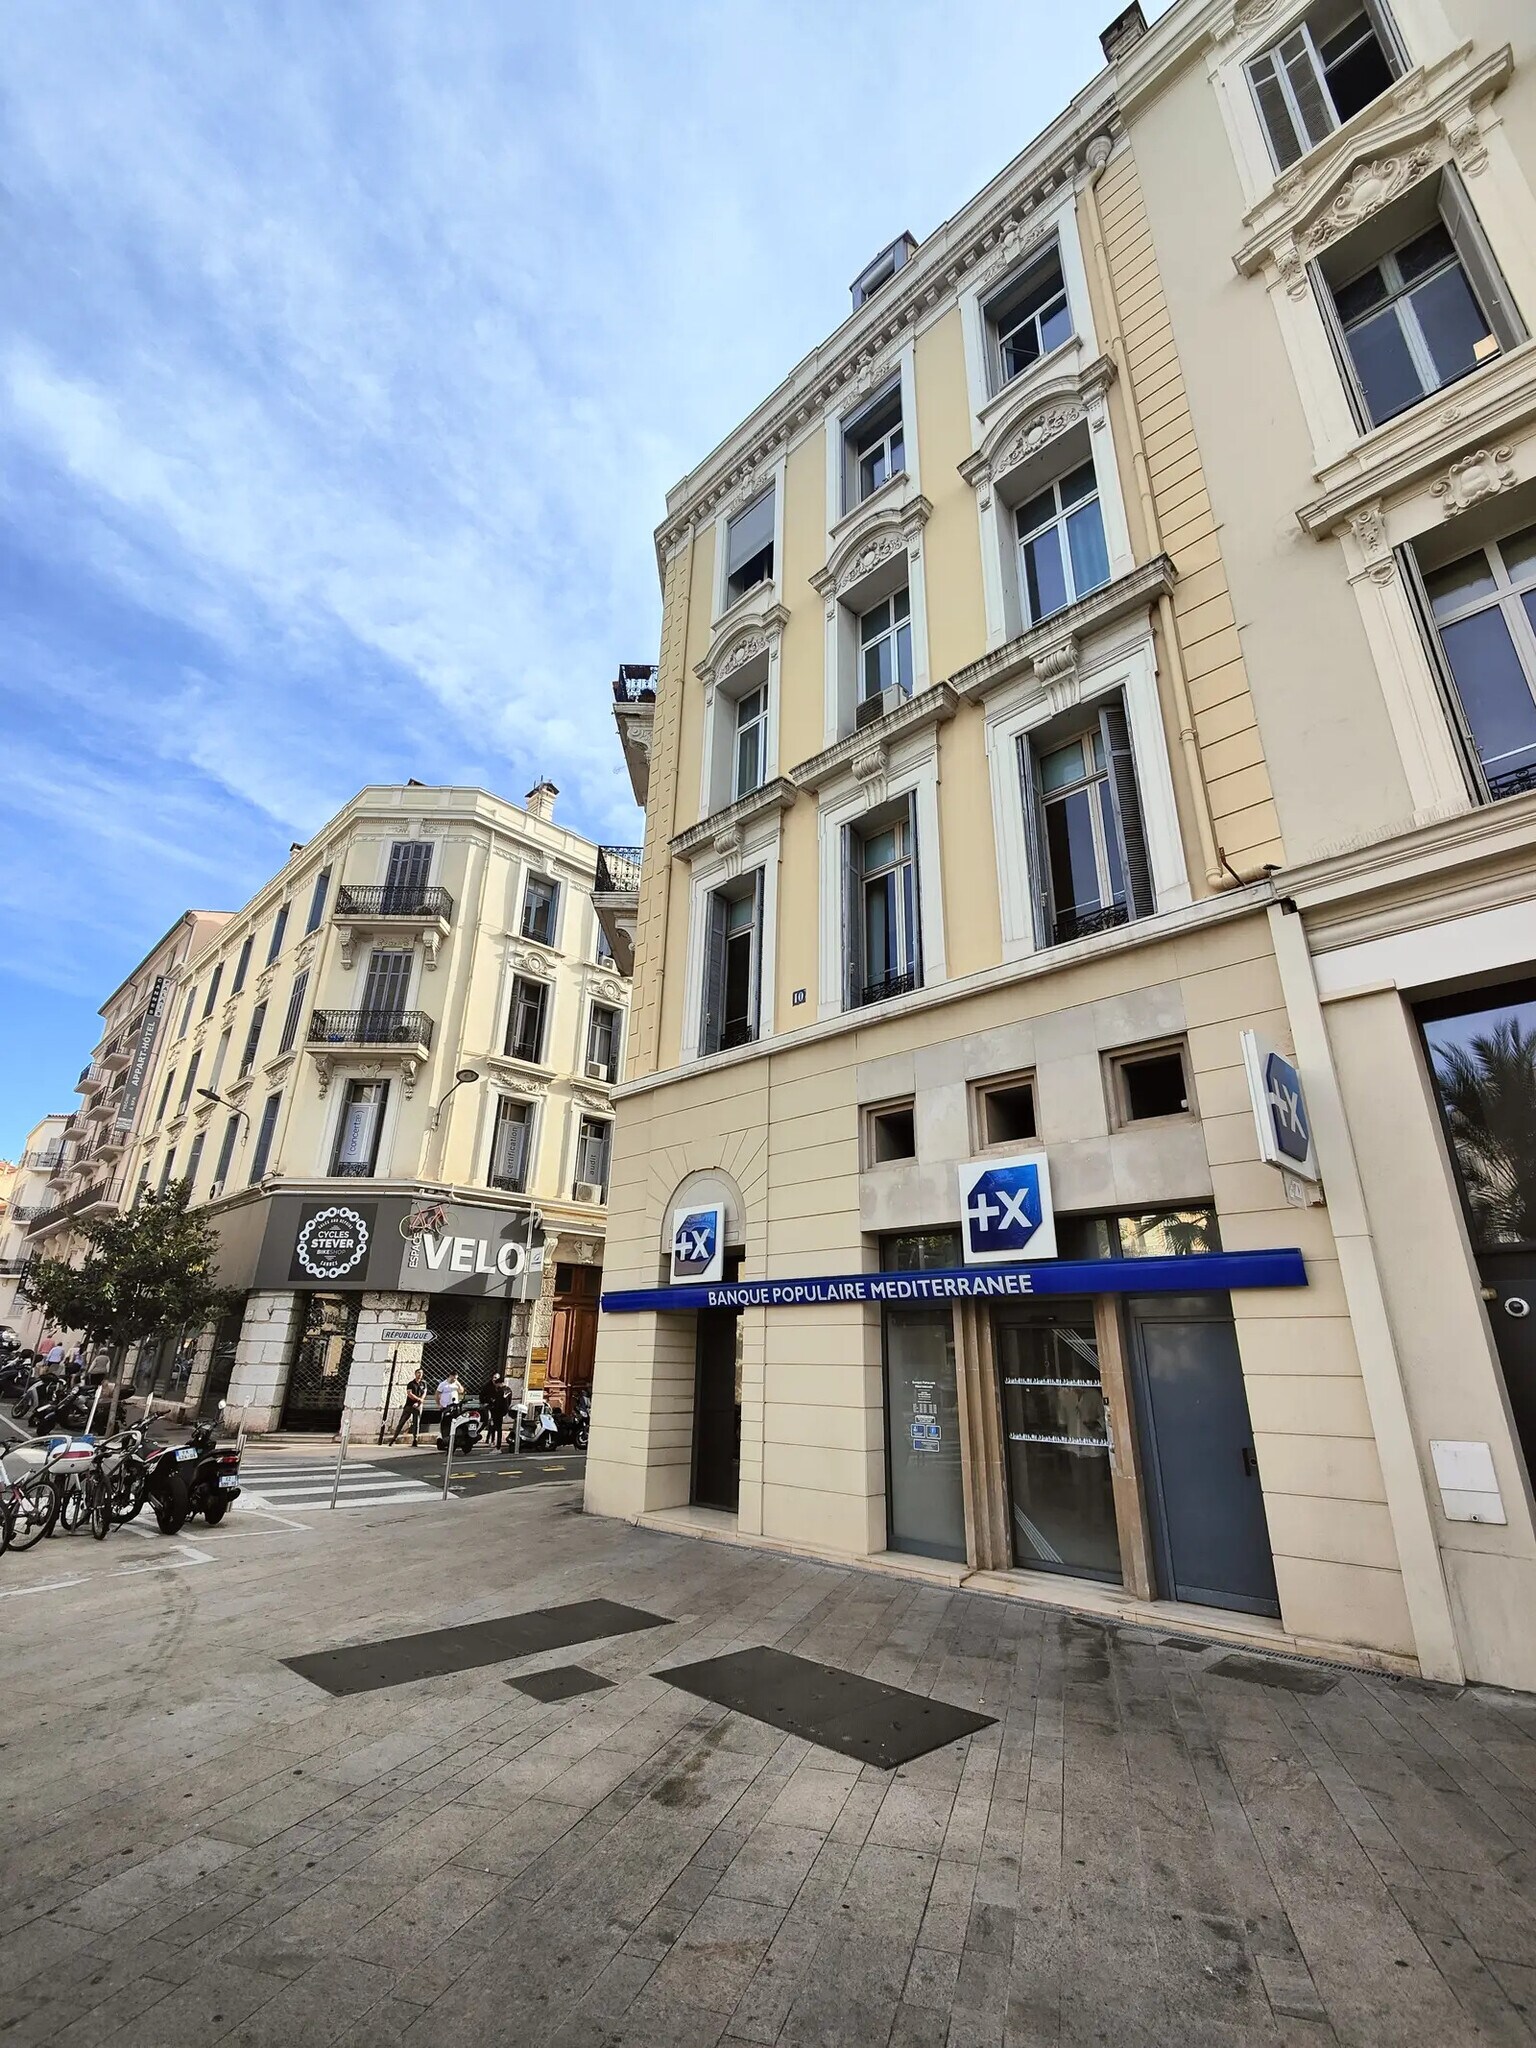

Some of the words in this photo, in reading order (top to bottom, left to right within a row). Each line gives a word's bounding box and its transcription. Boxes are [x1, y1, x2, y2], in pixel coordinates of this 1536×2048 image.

[149, 978, 162, 1015] CANNES
[156, 980, 169, 1016] PALAIS
[794, 991, 804, 1004] 10
[131, 1021, 156, 1087] APPART-HÔTEL
[506, 1127, 518, 1174] certification
[589, 1154, 597, 1175] audit
[310, 1238, 354, 1248] STEVER
[317, 1230, 350, 1239] CYCLES
[408, 1232, 422, 1268] ESPACE
[422, 1233, 526, 1277] VELO
[708, 1288, 770, 1306] BANQUE
[772, 1282, 867, 1303] POPULAIRE
[870, 1274, 1034, 1299] MEDITERRANEE
[385, 1330, 429, 1340] RÉPUBLIQUE
